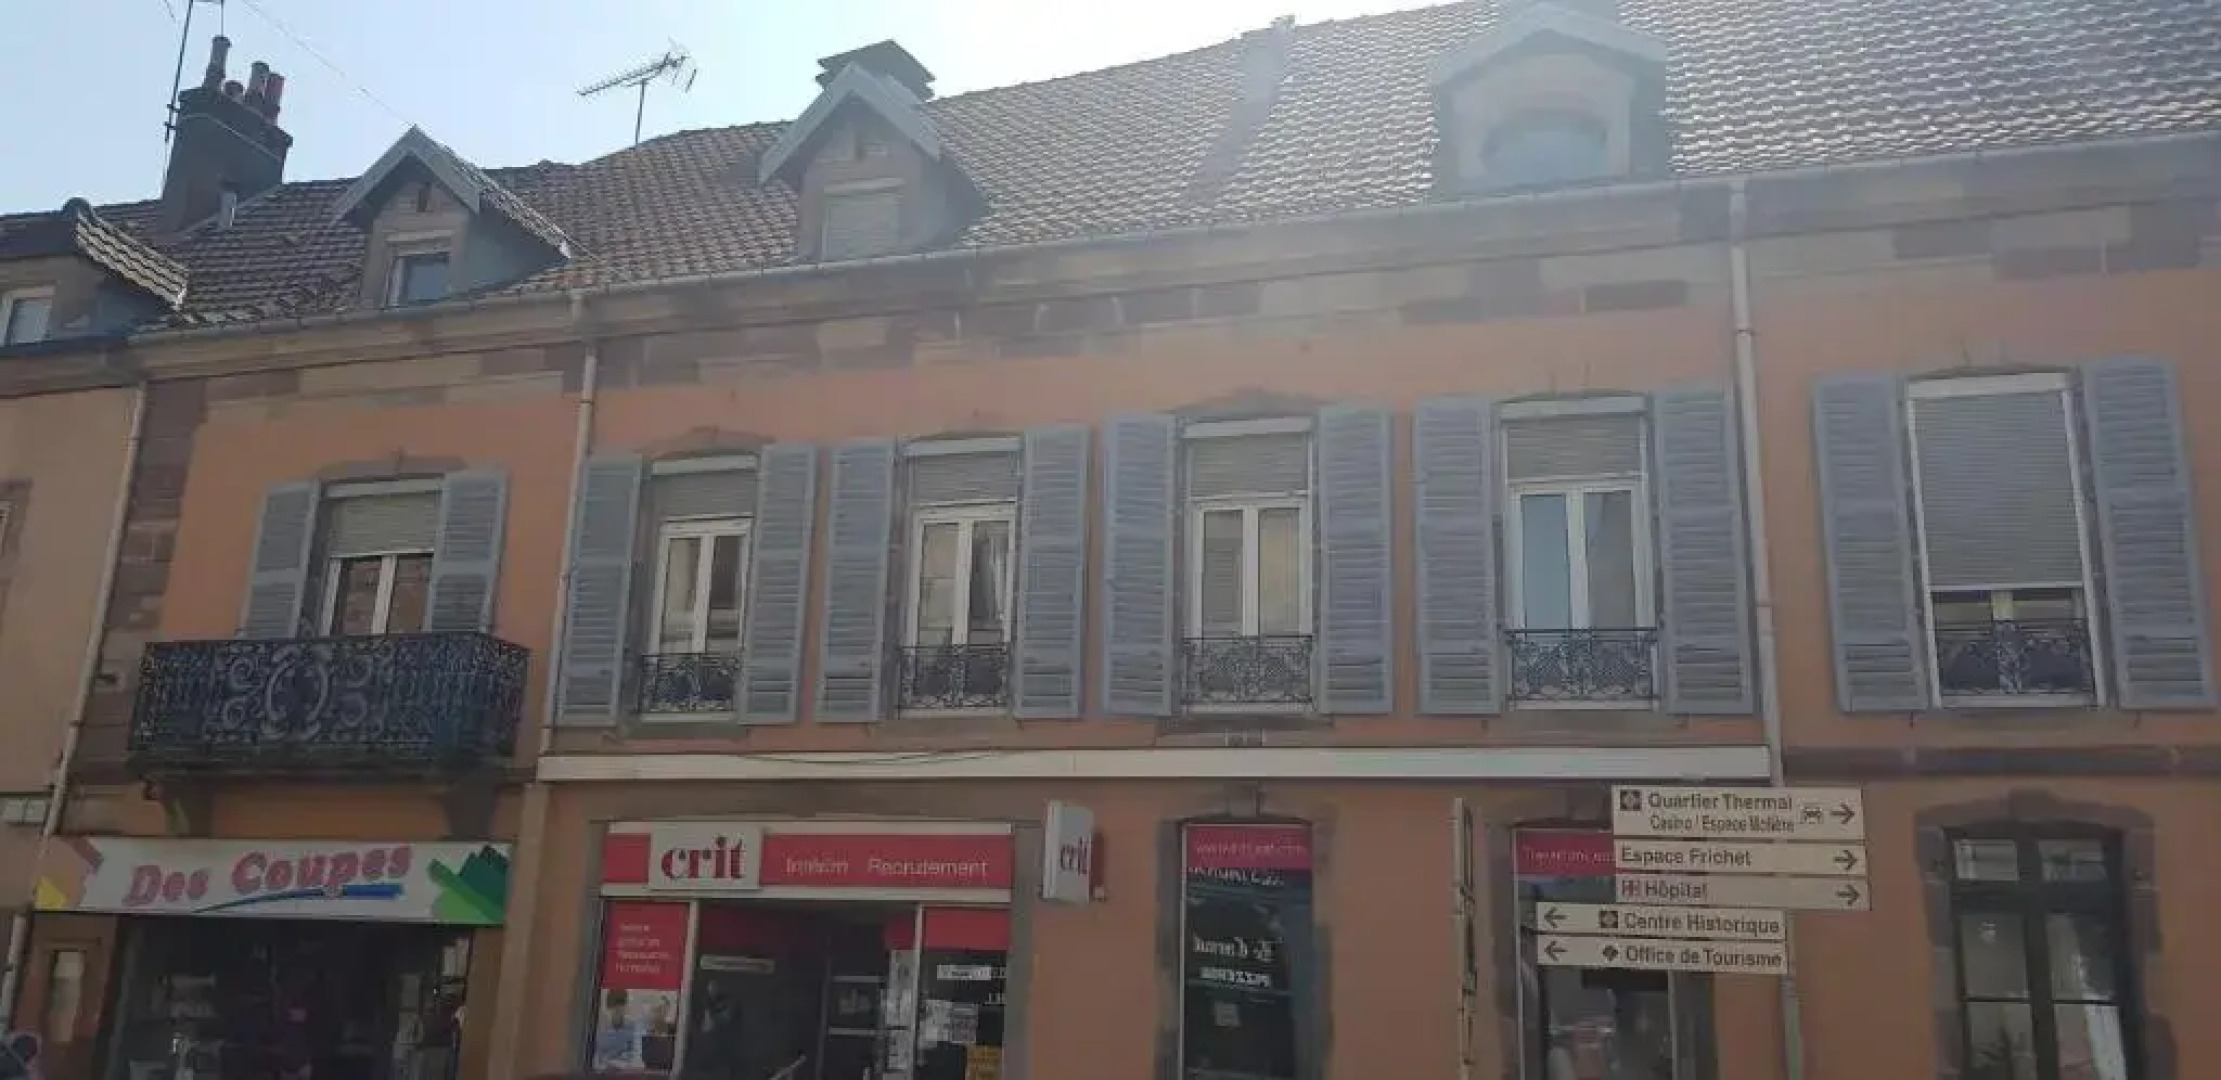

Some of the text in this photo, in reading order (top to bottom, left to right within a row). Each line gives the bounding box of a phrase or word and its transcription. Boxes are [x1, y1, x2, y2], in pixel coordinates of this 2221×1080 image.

[1649, 793, 1792, 810] Quartier Thermal
[1650, 815, 1692, 830] Casino
[1702, 815, 1746, 833] Espace
[661, 836, 747, 881] crit
[1622, 846, 1684, 866] Espace
[1690, 848, 1754, 866] Frichet
[123, 845, 413, 907] Des Coupes
[867, 857, 989, 878] Recrutement
[1645, 879, 1708, 900] Hôpital
[1624, 912, 1780, 937] Centre Historique
[1626, 945, 1782, 966] Office de Tourisme
